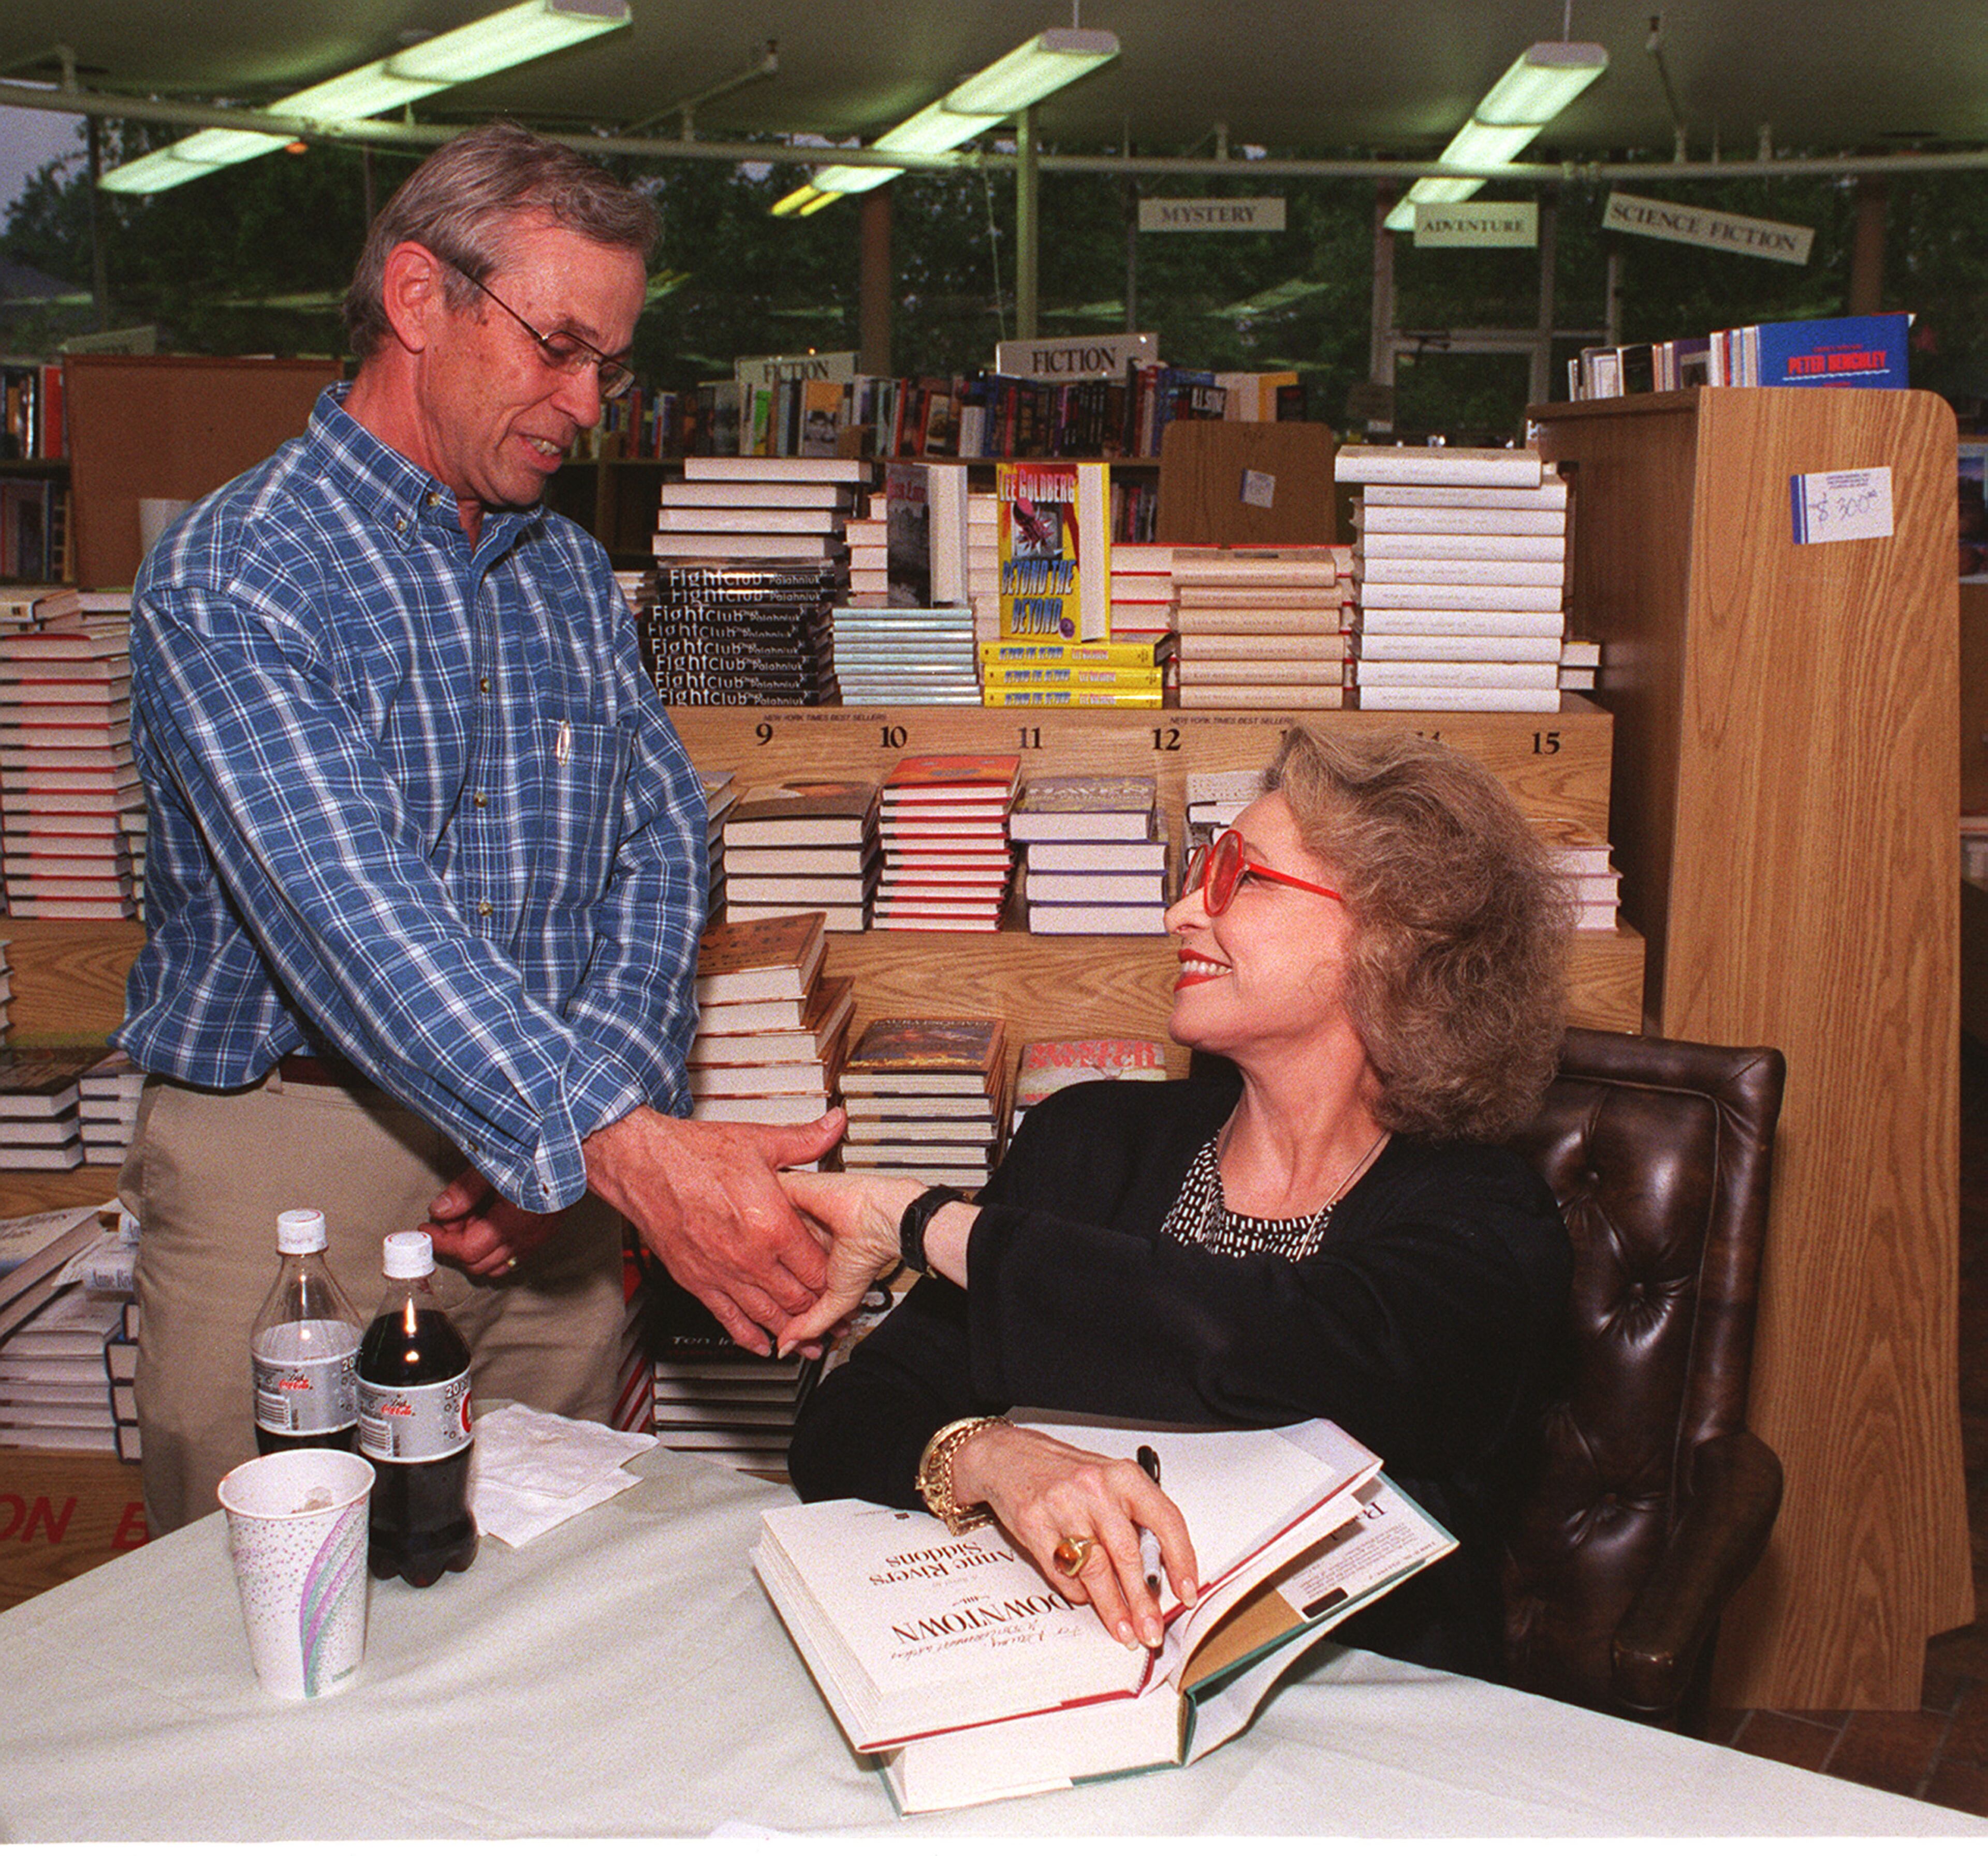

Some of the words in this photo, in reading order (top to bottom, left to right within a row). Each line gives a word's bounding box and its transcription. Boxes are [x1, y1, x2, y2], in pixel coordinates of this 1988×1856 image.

[1162, 207, 1256, 222] MYSTERY
[1423, 220, 1525, 232] ADVENTURE
[1610, 202, 1699, 234] SCIENCE
[1709, 220, 1798, 251] FICTION
[1032, 346, 1117, 373] FICTION
[1788, 355, 1825, 374] PETER
[1001, 559, 1049, 595] BEYOND
[1050, 559, 1077, 595] THE
[1011, 597, 1063, 634] BEYOND
[756, 723, 773, 746] 9
[880, 726, 907, 748] 10
[1018, 727, 1043, 749] 11
[1152, 728, 1181, 751] 12
[1532, 732, 1560, 754] 15
[885, 1541, 983, 1568] Siddons
[955, 1549, 1016, 1569] Anne
[869, 1565, 949, 1586] Rivers
[891, 1594, 1075, 1644] DOWNTOWN
